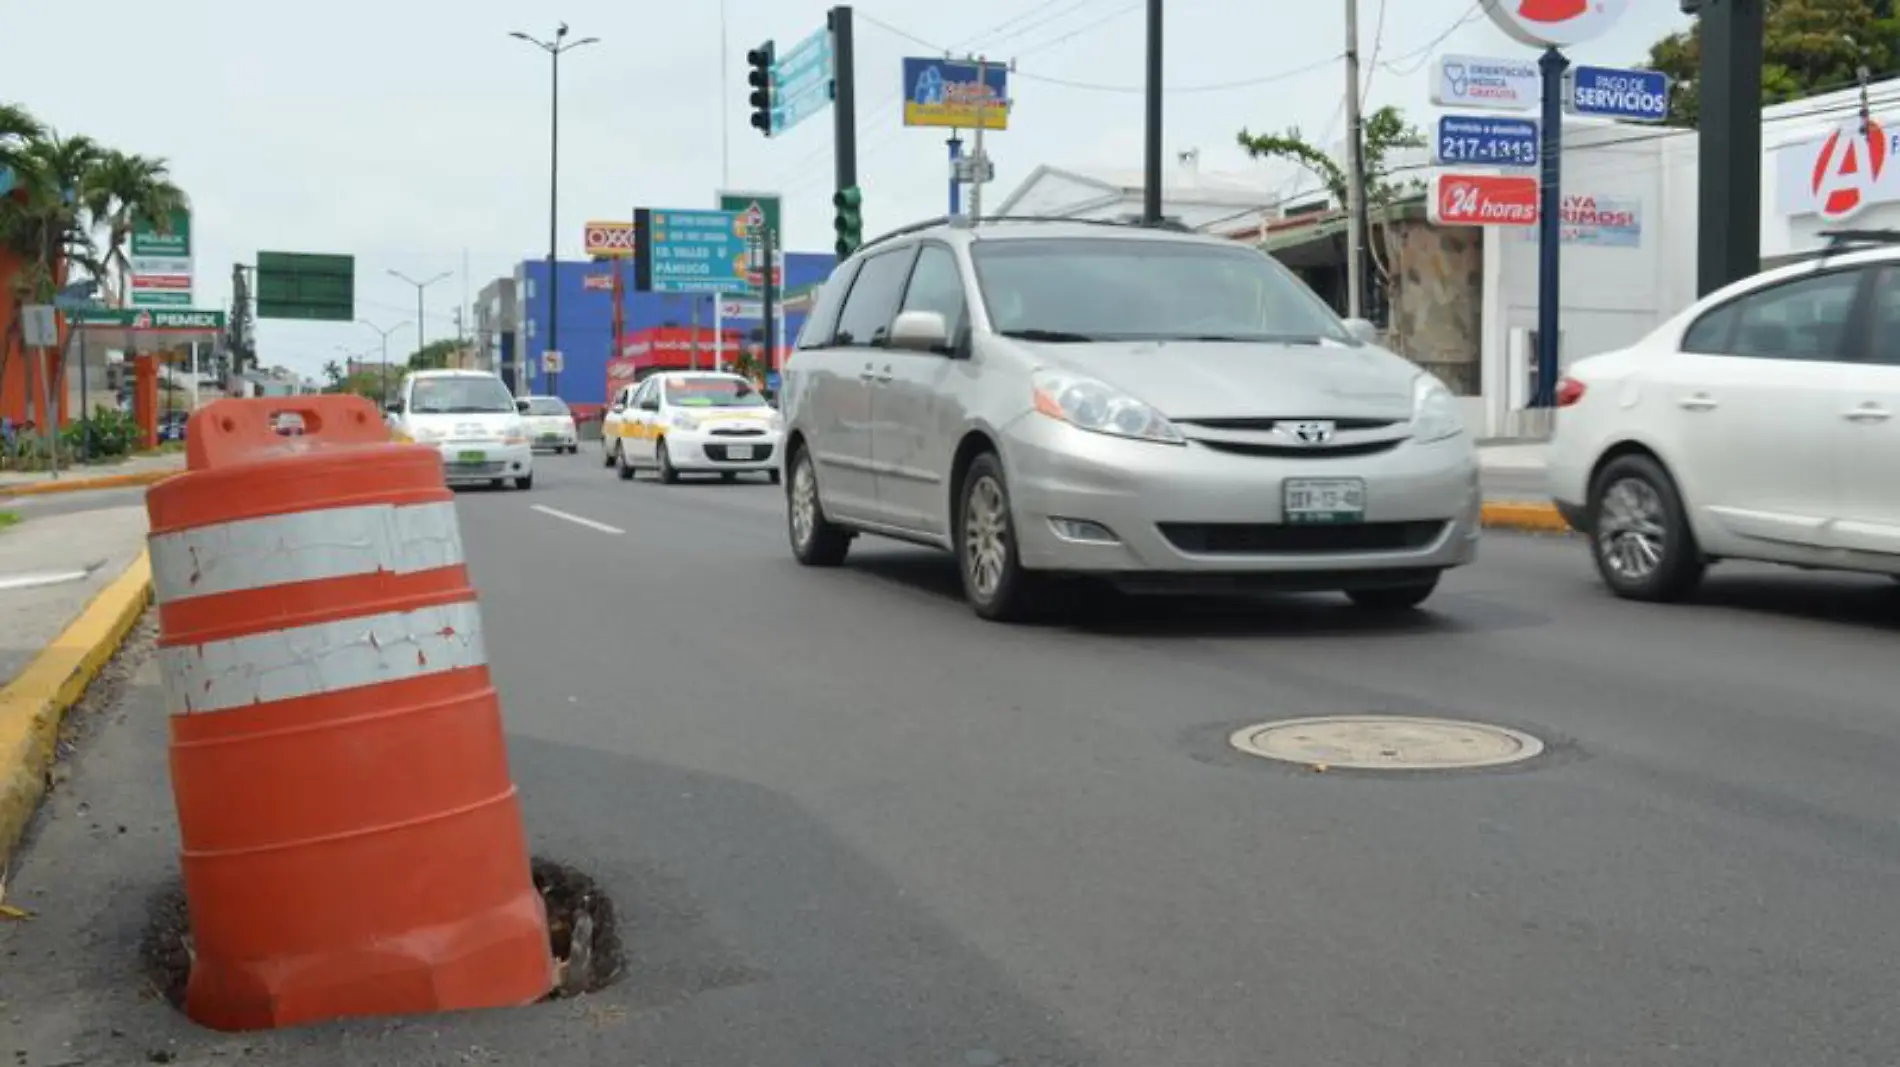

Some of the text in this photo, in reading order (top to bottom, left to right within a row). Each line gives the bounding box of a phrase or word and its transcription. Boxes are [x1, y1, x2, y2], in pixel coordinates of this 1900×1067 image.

[1469, 87, 1517, 99] GRATUITA
[1596, 75, 1646, 93] PAGO DE
[1576, 87, 1665, 113] SERVICIOS
[1451, 188, 1534, 220] 24 horas
[156, 313, 216, 326] PEMEX
